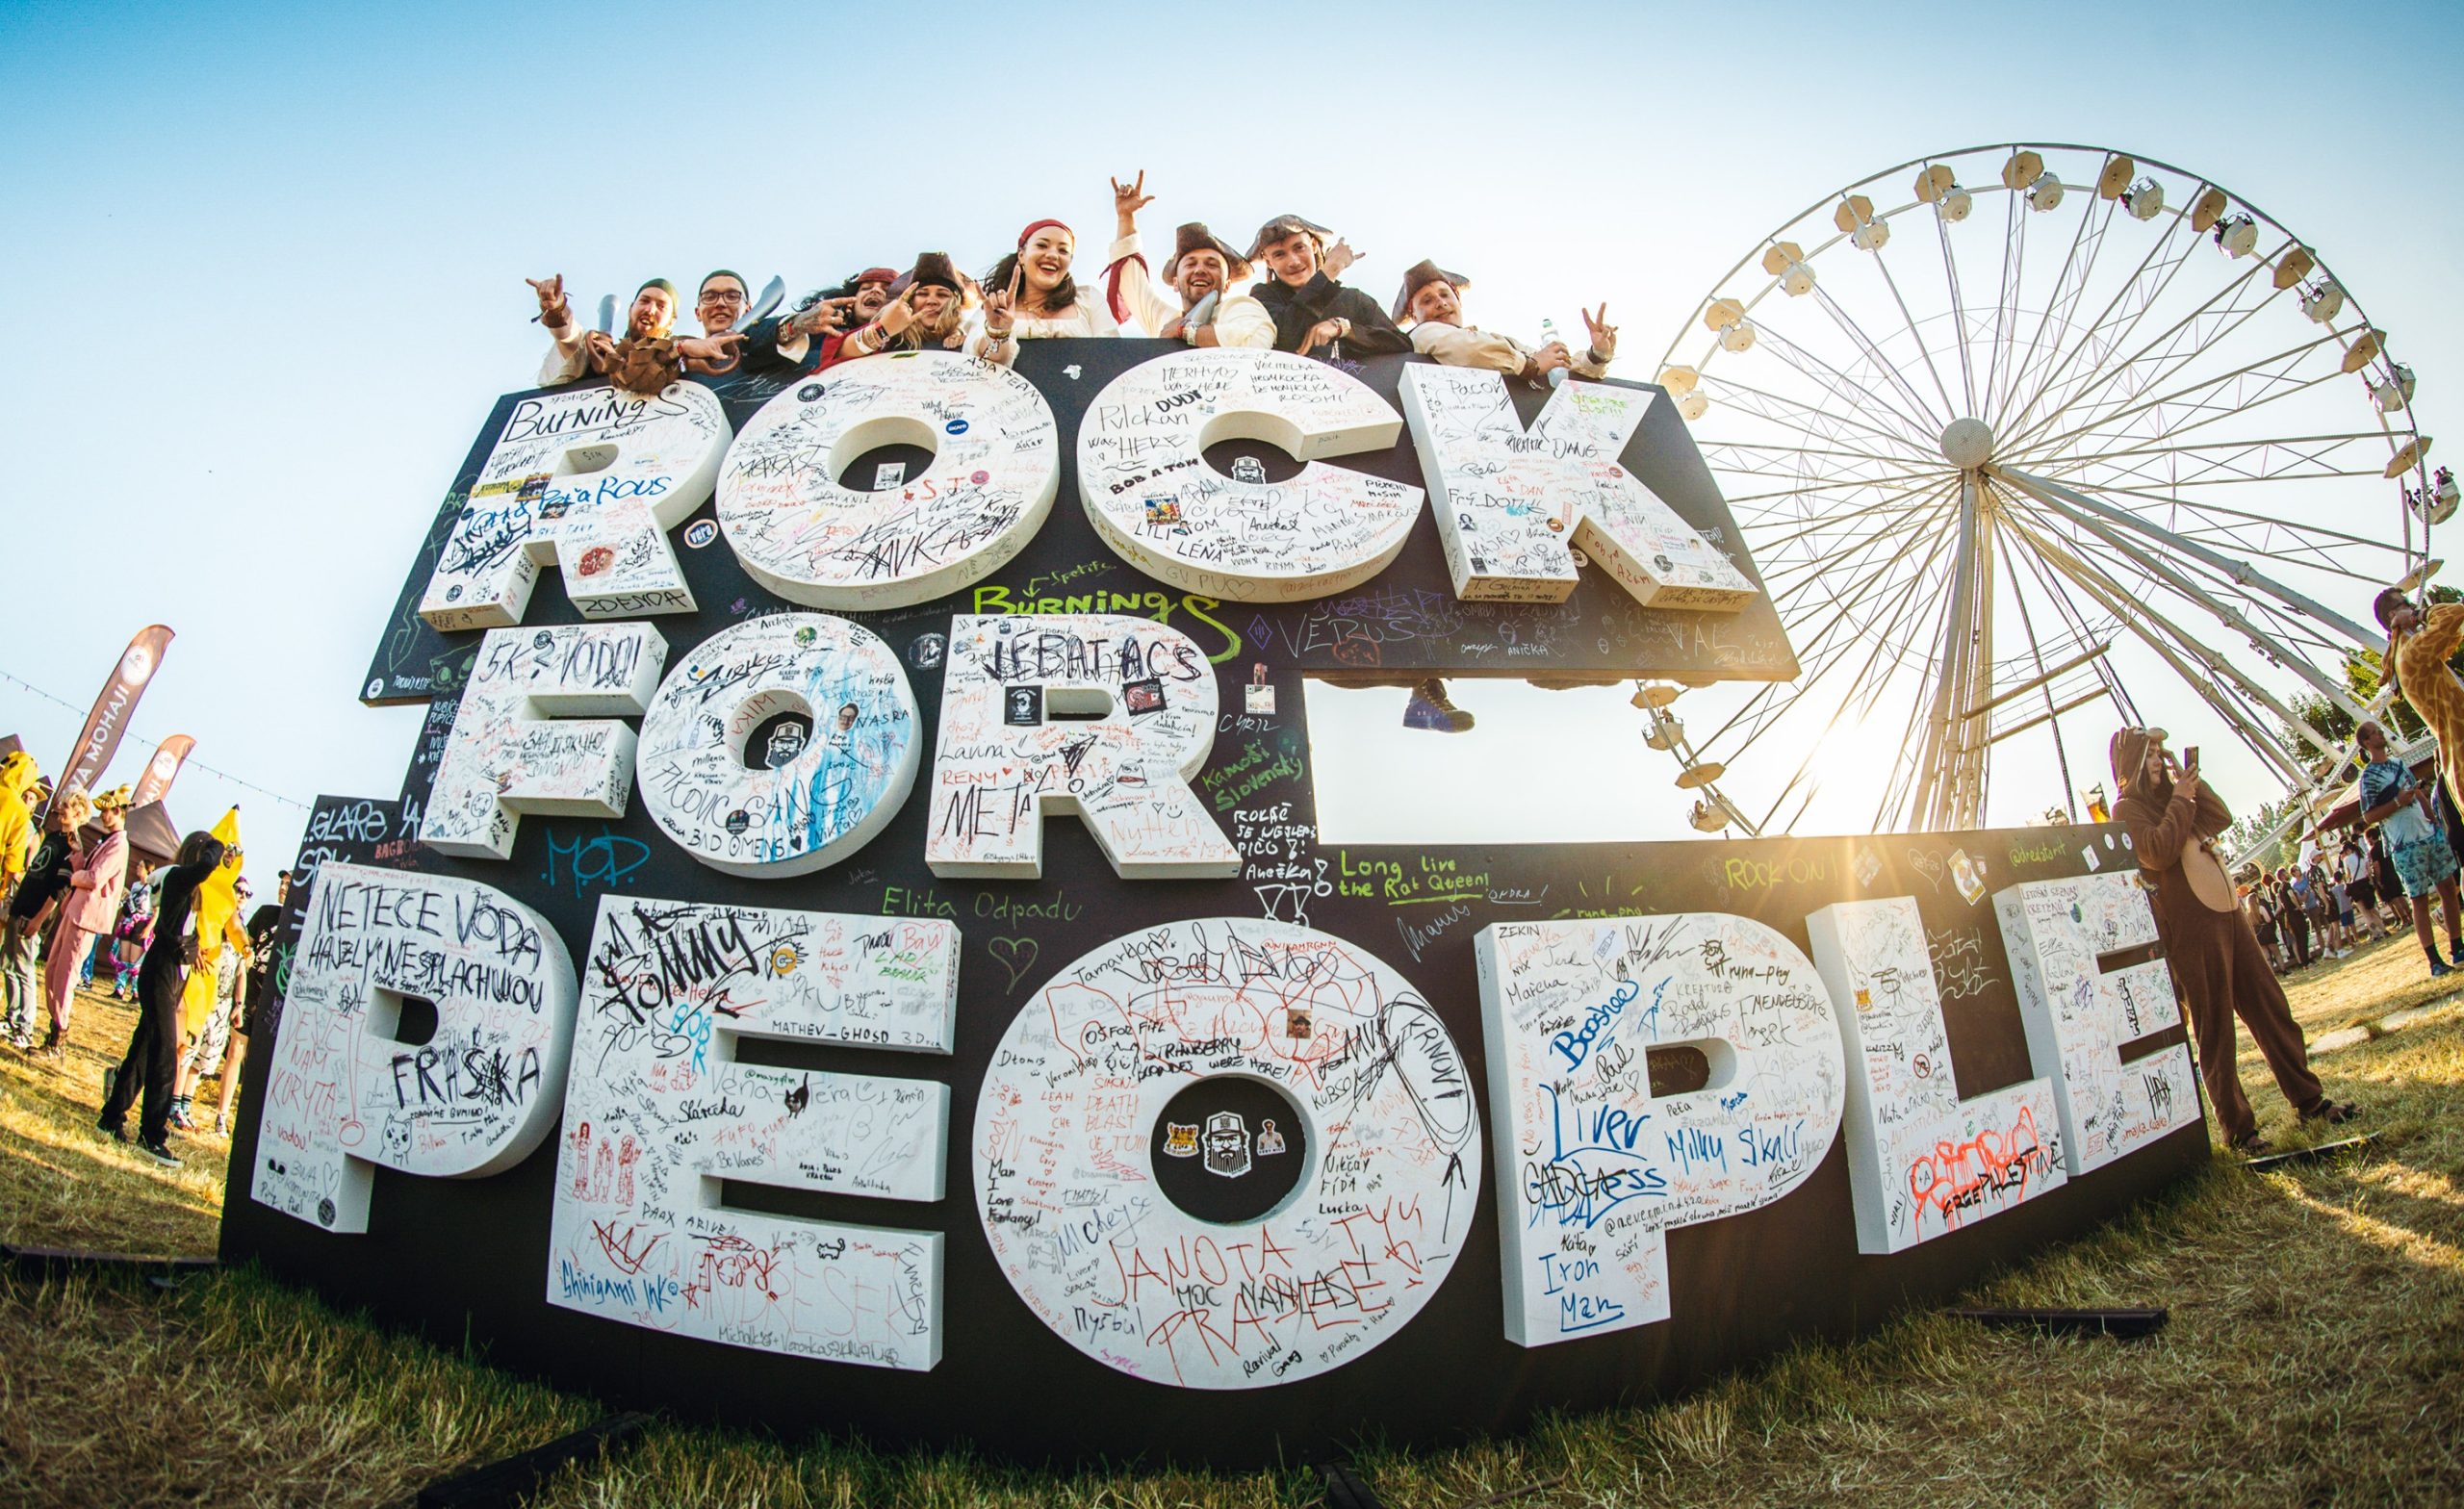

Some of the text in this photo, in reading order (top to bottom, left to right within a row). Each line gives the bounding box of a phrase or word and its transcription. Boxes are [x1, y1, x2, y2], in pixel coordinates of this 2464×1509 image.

[419, 348, 1760, 635] ROCK
[1110, 473, 1146, 495] BOB
[1508, 642, 1549, 656] ANIČKA
[86, 683, 130, 762] MOHAJI
[420, 612, 1242, 879] FOR
[687, 829, 785, 858] BAD OMENS
[1342, 851, 1456, 878] Long live
[1340, 871, 1489, 898] the Rat Queen!
[883, 886, 1082, 931] Elita Odpadu
[456, 890, 541, 976] VODA
[1499, 925, 1540, 939] ZEKIN
[1040, 1092, 1073, 1102] LEAH
[1085, 1093, 1139, 1113] DEATH
[250, 861, 2206, 1394] PEOPLE
[988, 1160, 1016, 1180] Man
[1539, 1252, 1599, 1294] Iron
[1561, 1292, 1624, 1321] Man
